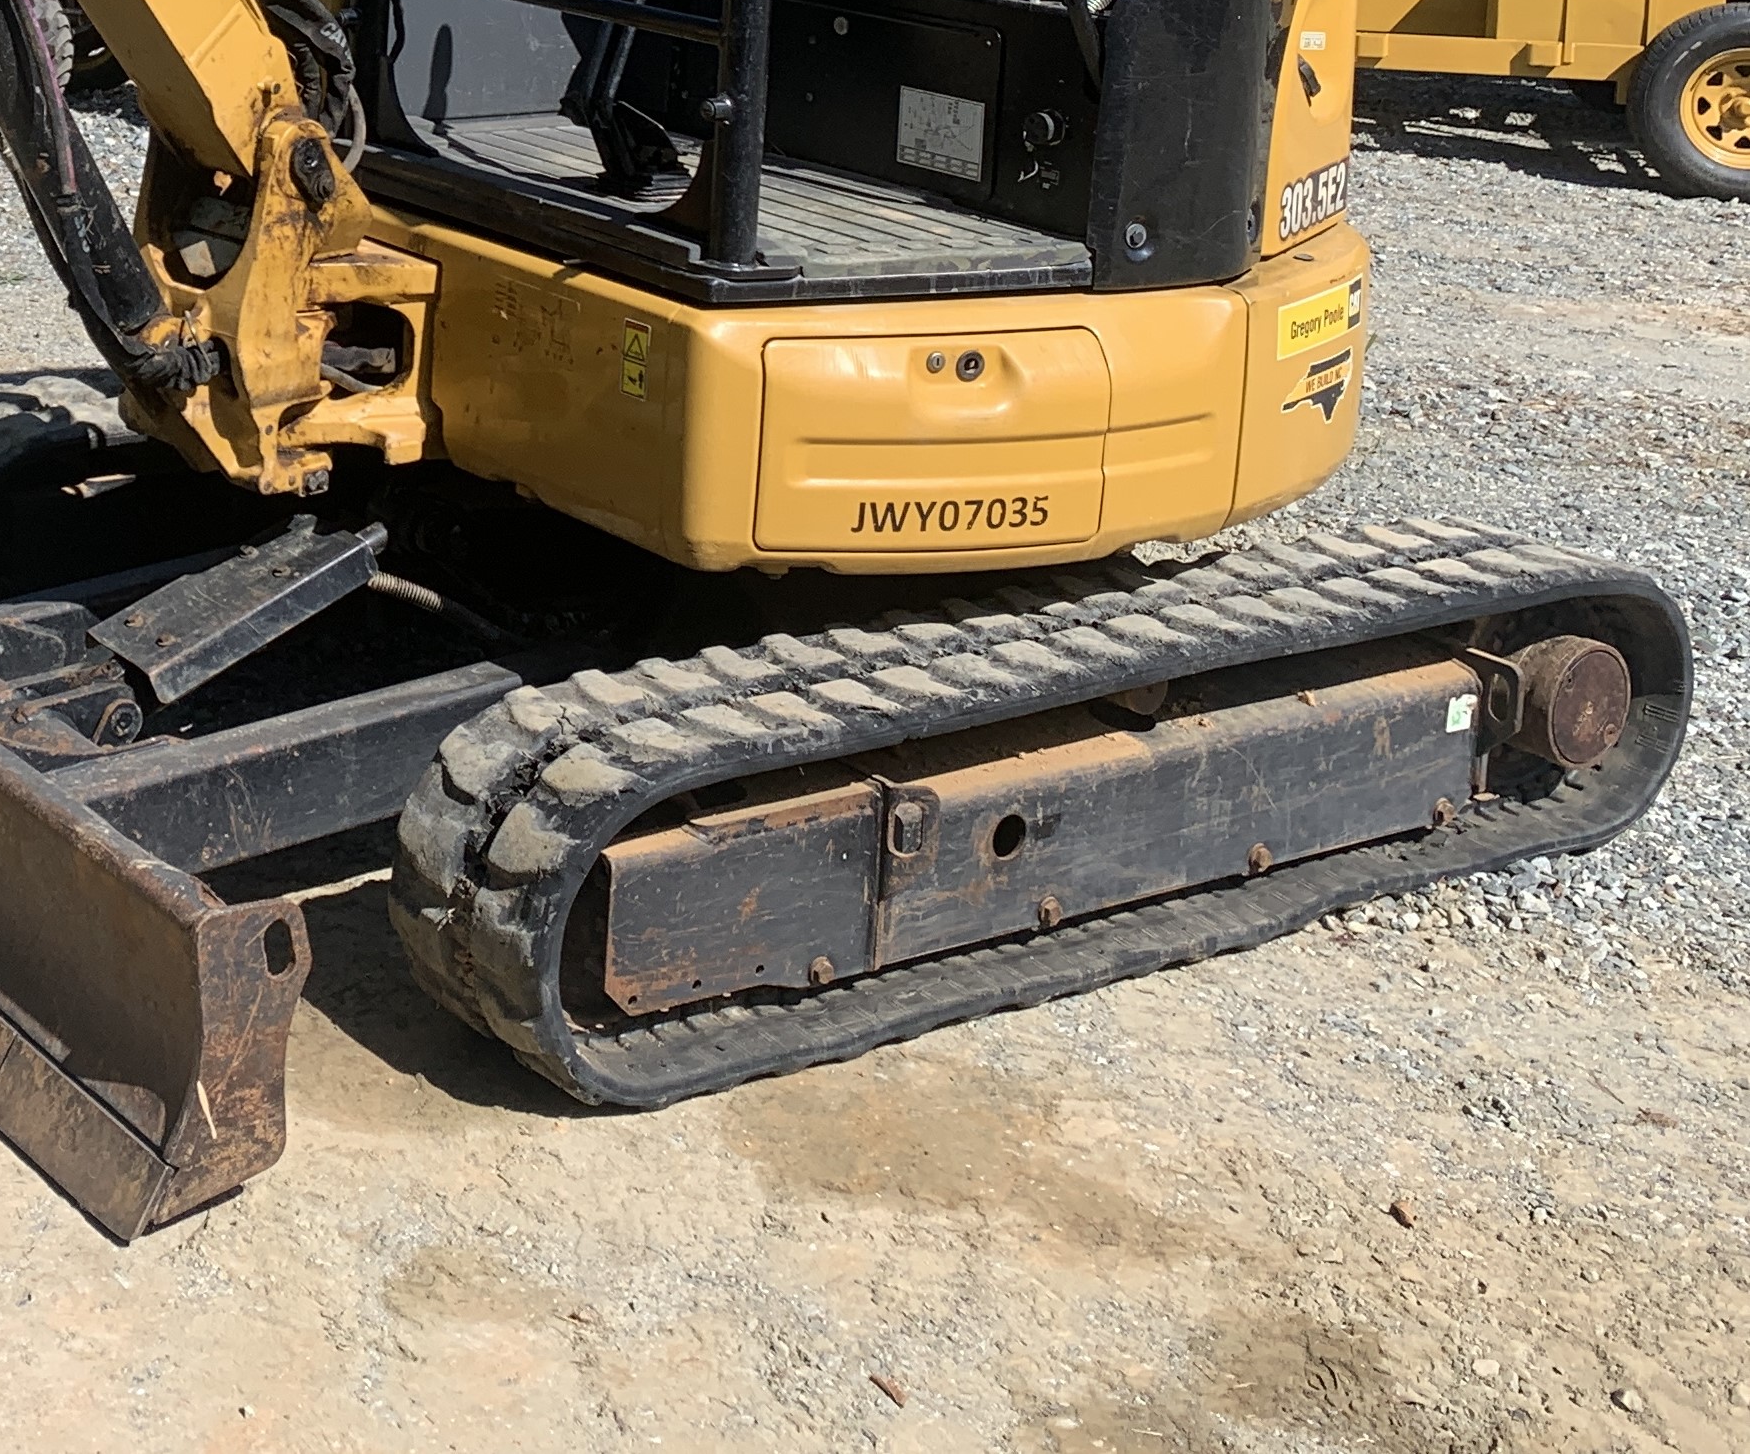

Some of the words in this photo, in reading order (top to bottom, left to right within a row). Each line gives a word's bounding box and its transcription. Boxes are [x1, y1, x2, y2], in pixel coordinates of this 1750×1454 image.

[1280, 162, 1346, 238] 303.5E2
[1290, 315, 1322, 340] Gregory
[1323, 303, 1345, 328] Poole
[1316, 371, 1333, 390] BUILD
[851, 495, 1049, 533] JWY07035
